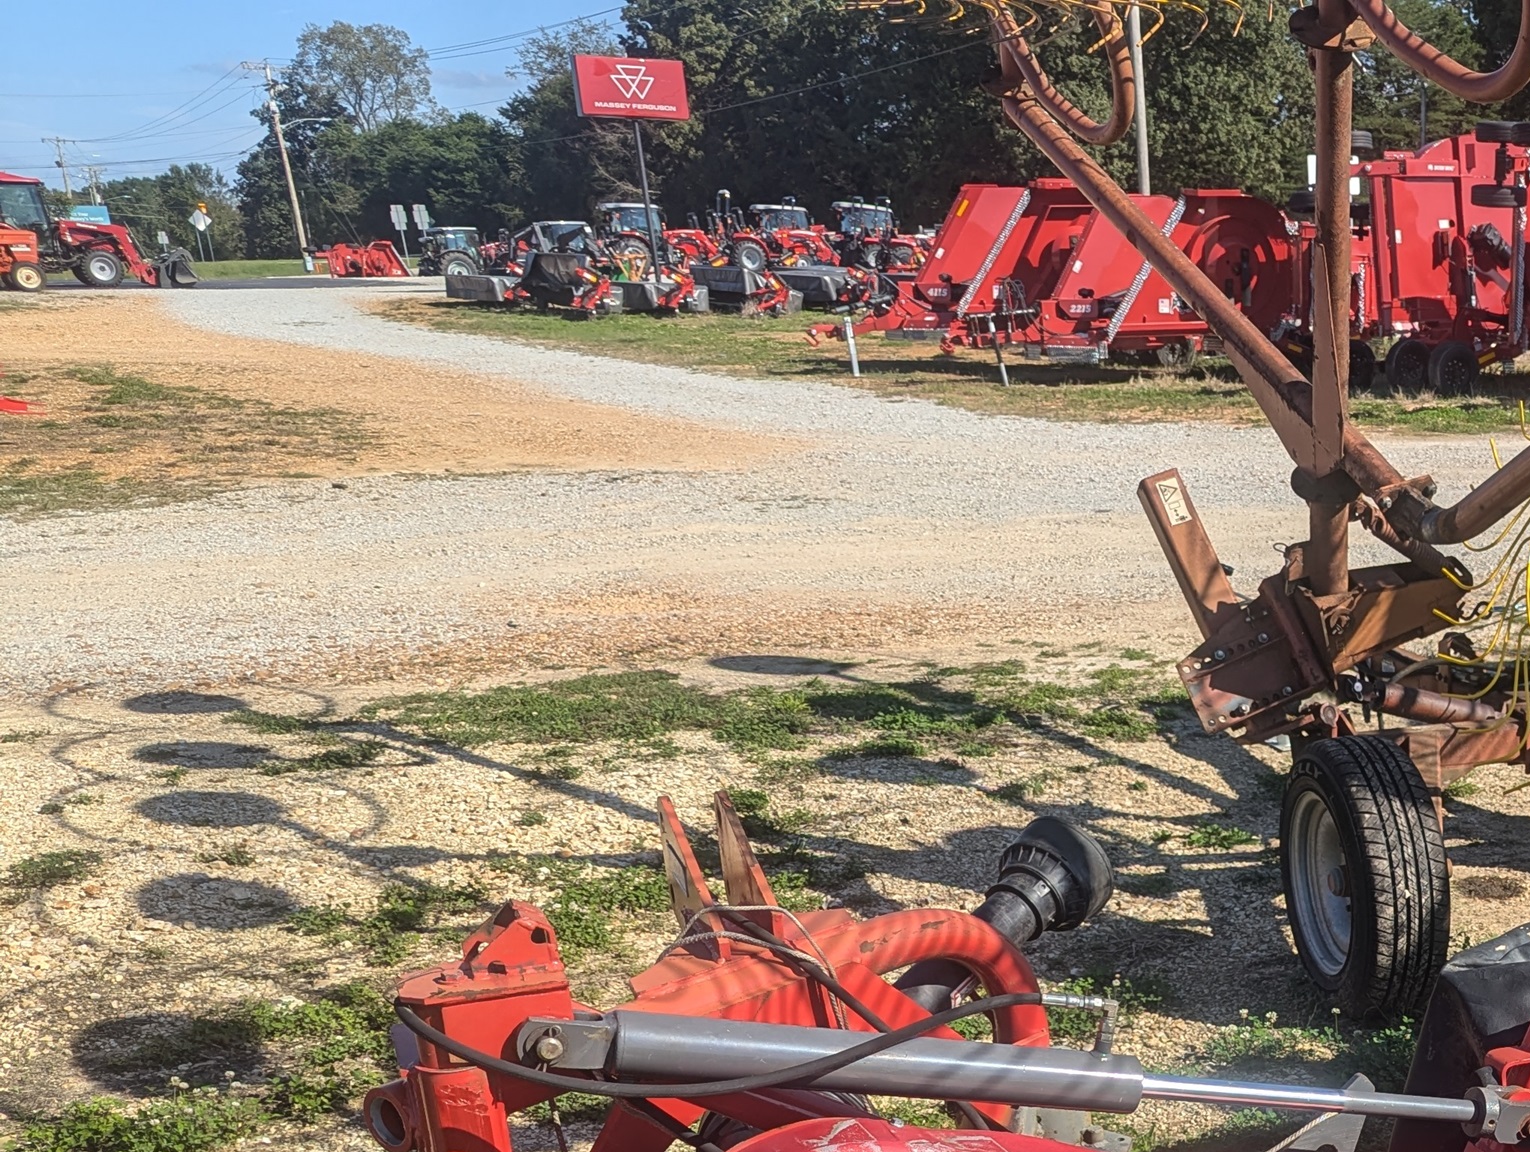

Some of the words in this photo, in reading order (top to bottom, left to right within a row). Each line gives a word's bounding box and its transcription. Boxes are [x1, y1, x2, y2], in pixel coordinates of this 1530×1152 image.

[594, 101, 631, 109] MASSEY
[631, 103, 677, 112] FERGUSON
[927, 287, 948, 296] 4115
[1069, 304, 1092, 313] 2215
